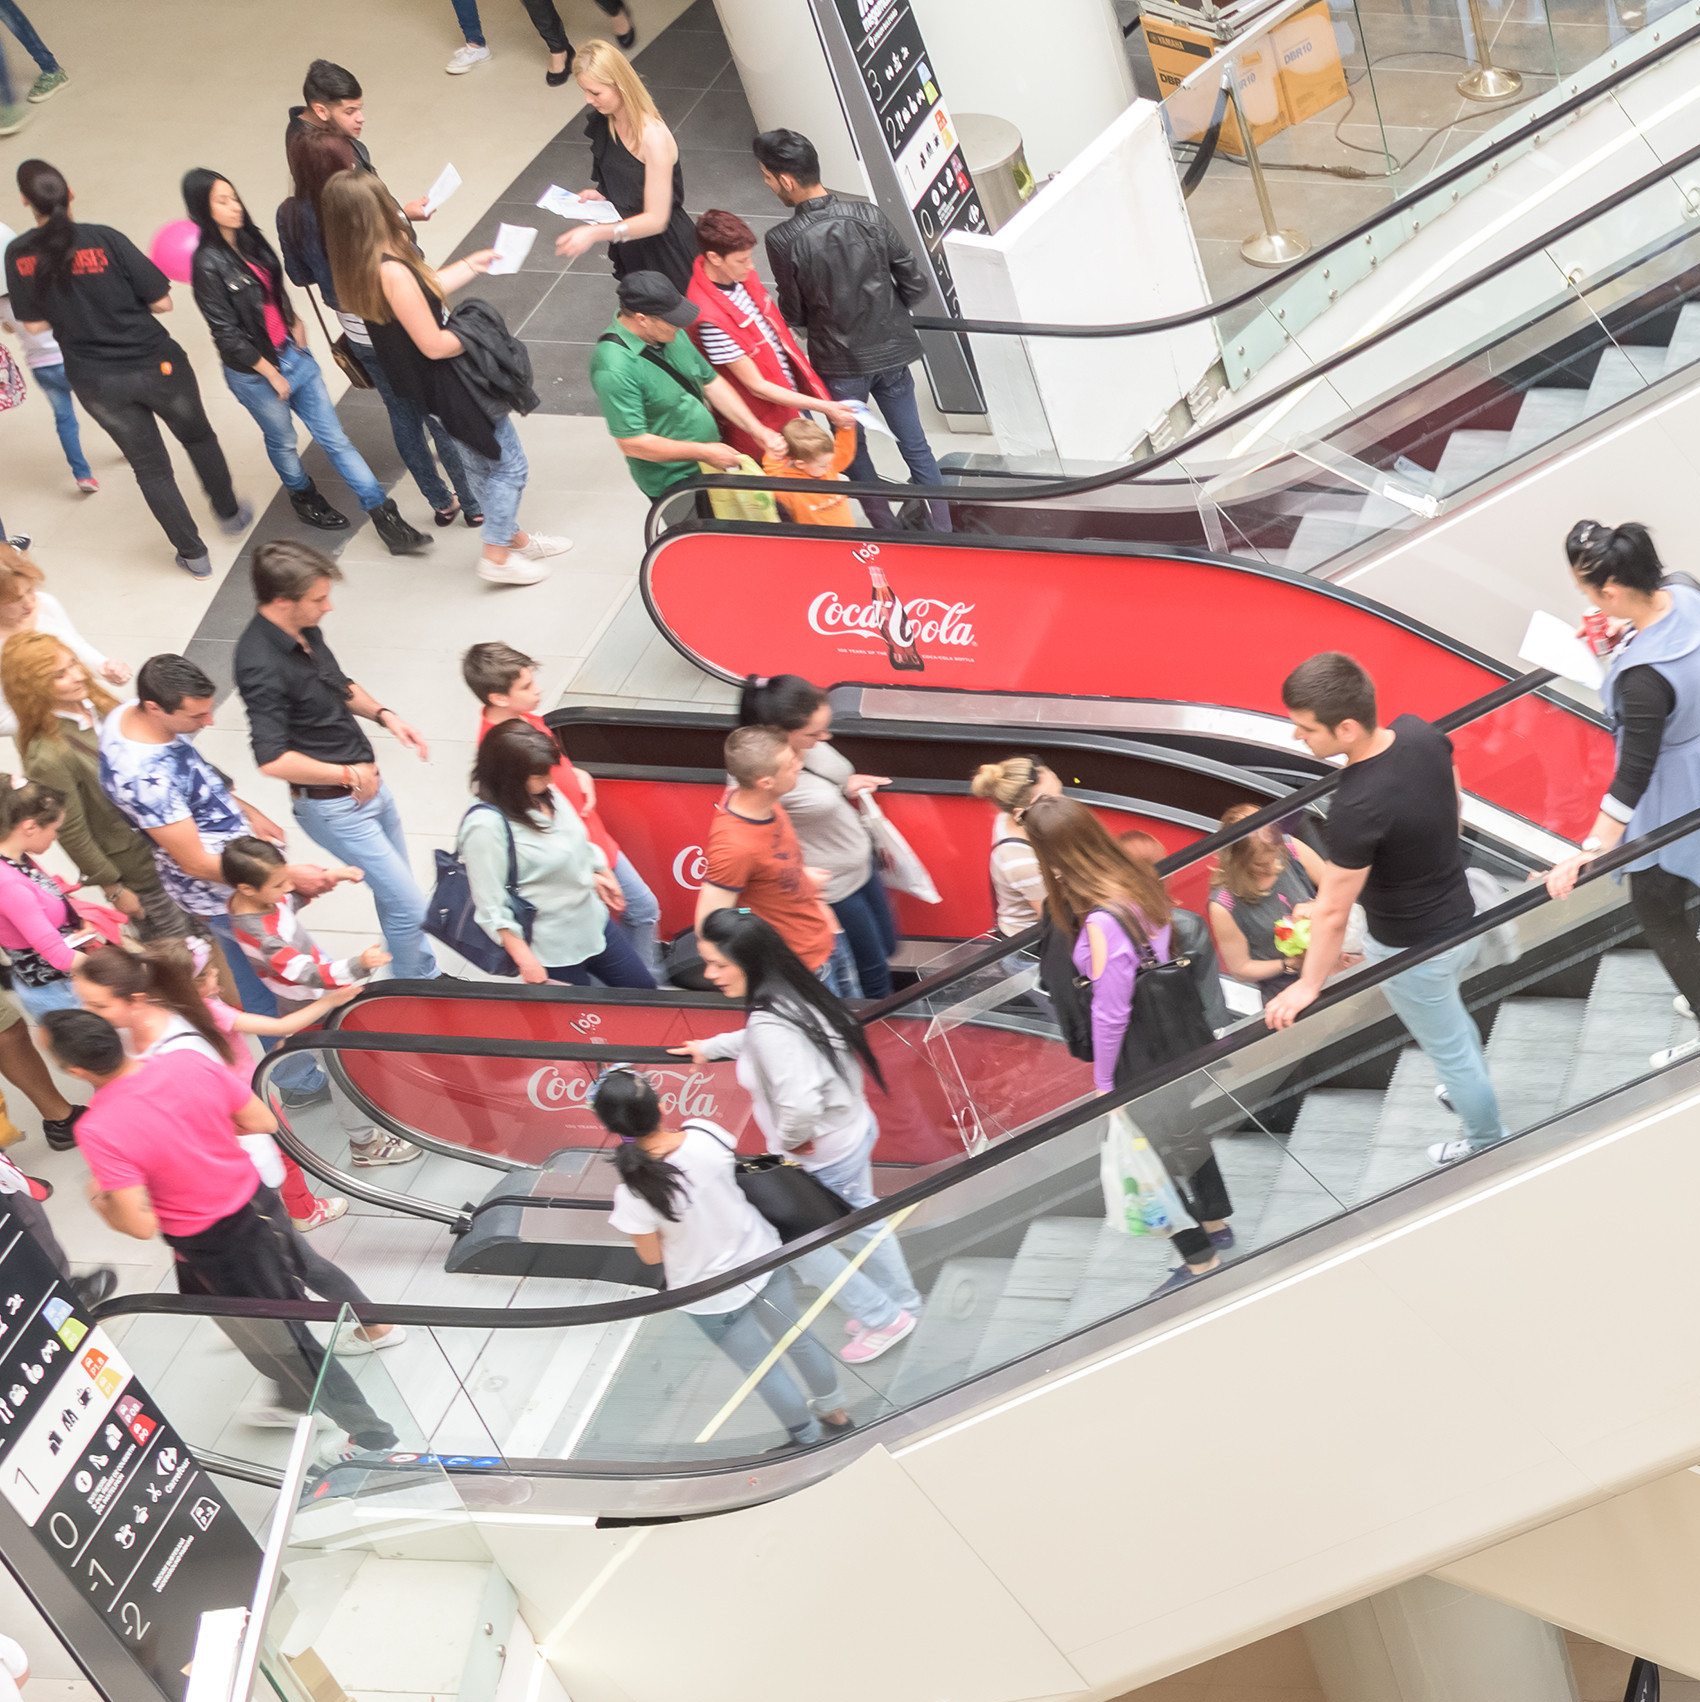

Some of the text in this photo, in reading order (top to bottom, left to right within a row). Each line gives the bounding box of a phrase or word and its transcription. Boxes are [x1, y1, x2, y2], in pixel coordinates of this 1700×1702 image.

[1158, 36, 1185, 49] YAMAHA
[1283, 42, 1313, 65] DBR10
[867, 68, 883, 102] 3
[1160, 73, 1182, 87] DBR
[1238, 73, 1257, 91] R10
[885, 116, 901, 150] 2
[904, 164, 917, 191] 1
[920, 209, 935, 239] 0
[808, 591, 977, 648] Coca-Cola
[15, 1467, 40, 1495] 1
[164, 1457, 191, 1494] Carrefour
[50, 1512, 79, 1549] 0
[88, 1558, 115, 1592] -1
[121, 1602, 151, 1640] -2
